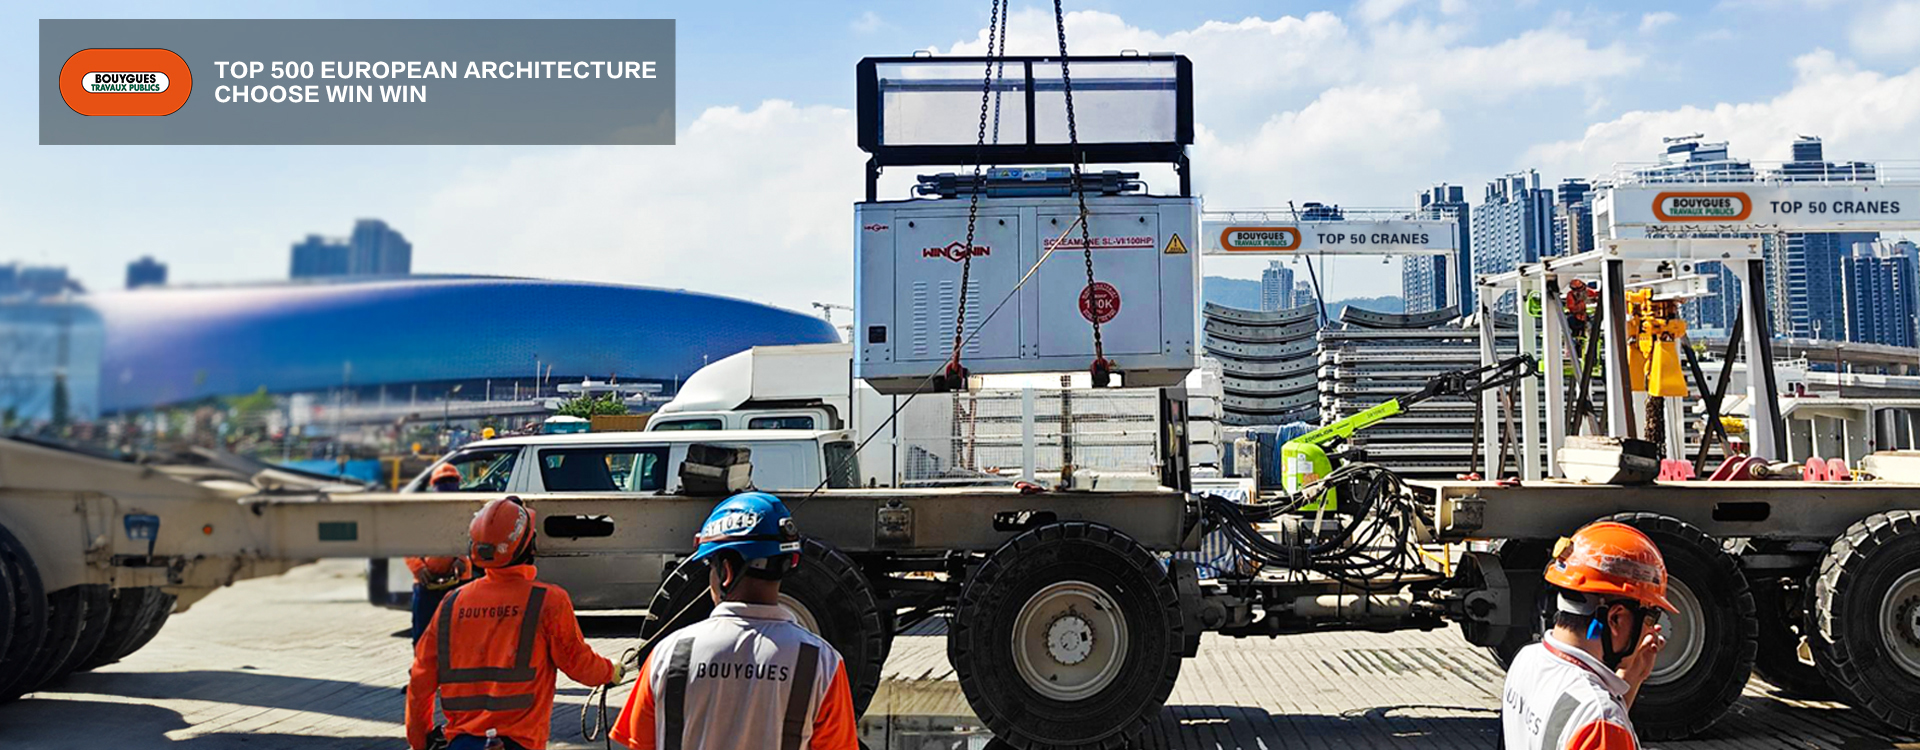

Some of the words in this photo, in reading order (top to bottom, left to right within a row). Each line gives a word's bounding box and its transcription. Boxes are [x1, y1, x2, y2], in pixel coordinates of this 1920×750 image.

[1672, 197, 1731, 208] BOUYGUES
[1770, 200, 1803, 214] TOP
[1808, 200, 1828, 214] 50
[1832, 200, 1901, 214] CRANES
[1669, 207, 1703, 216] TRAVAUX
[1705, 207, 1735, 216] PUBLICS
[1237, 232, 1284, 240] BOUYGUES
[1317, 233, 1346, 244] TOP
[1350, 233, 1366, 244] 50
[1371, 233, 1429, 244] CRANES
[1043, 237, 1099, 246] SCEAMLNE
[1234, 239, 1261, 247] TRAVAUX
[1263, 239, 1288, 247] PUBLICS
[1084, 299, 1114, 309] 10K
[459, 605, 519, 619] BOUYGUES
[696, 662, 789, 682] BOUYGUES
